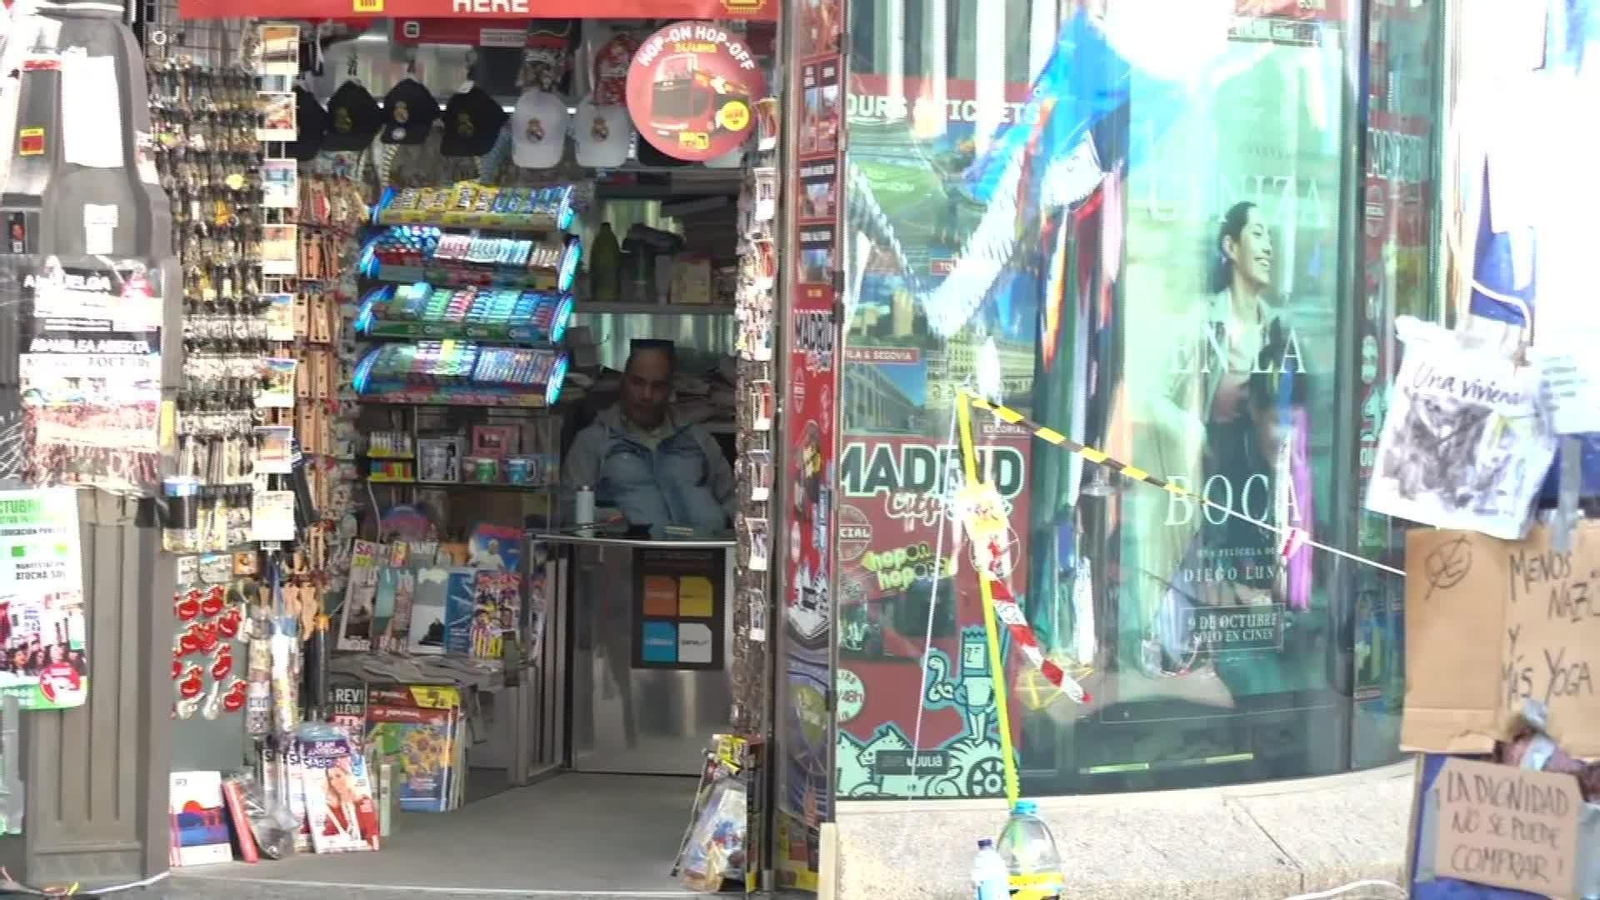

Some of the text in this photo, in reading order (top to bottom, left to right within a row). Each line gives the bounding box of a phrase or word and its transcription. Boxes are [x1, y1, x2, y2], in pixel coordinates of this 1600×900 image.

[637, 25, 755, 70] HOP-ON HOP-OFF
[873, 350, 913, 360] SEGOVIA
[840, 443, 1024, 499] MADRD
[1164, 474, 1302, 527] BOCA
[1184, 565, 1238, 582] DIEGO
[1509, 549, 1572, 602] MENOS
[1219, 612, 1277, 629] OCTUBRE
[1242, 628, 1273, 641] CINES
[1543, 646, 1594, 706] YOGA
[1473, 774, 1571, 816] DIGNIDAD
[1452, 806, 1563, 850] NO SE PUEDE
